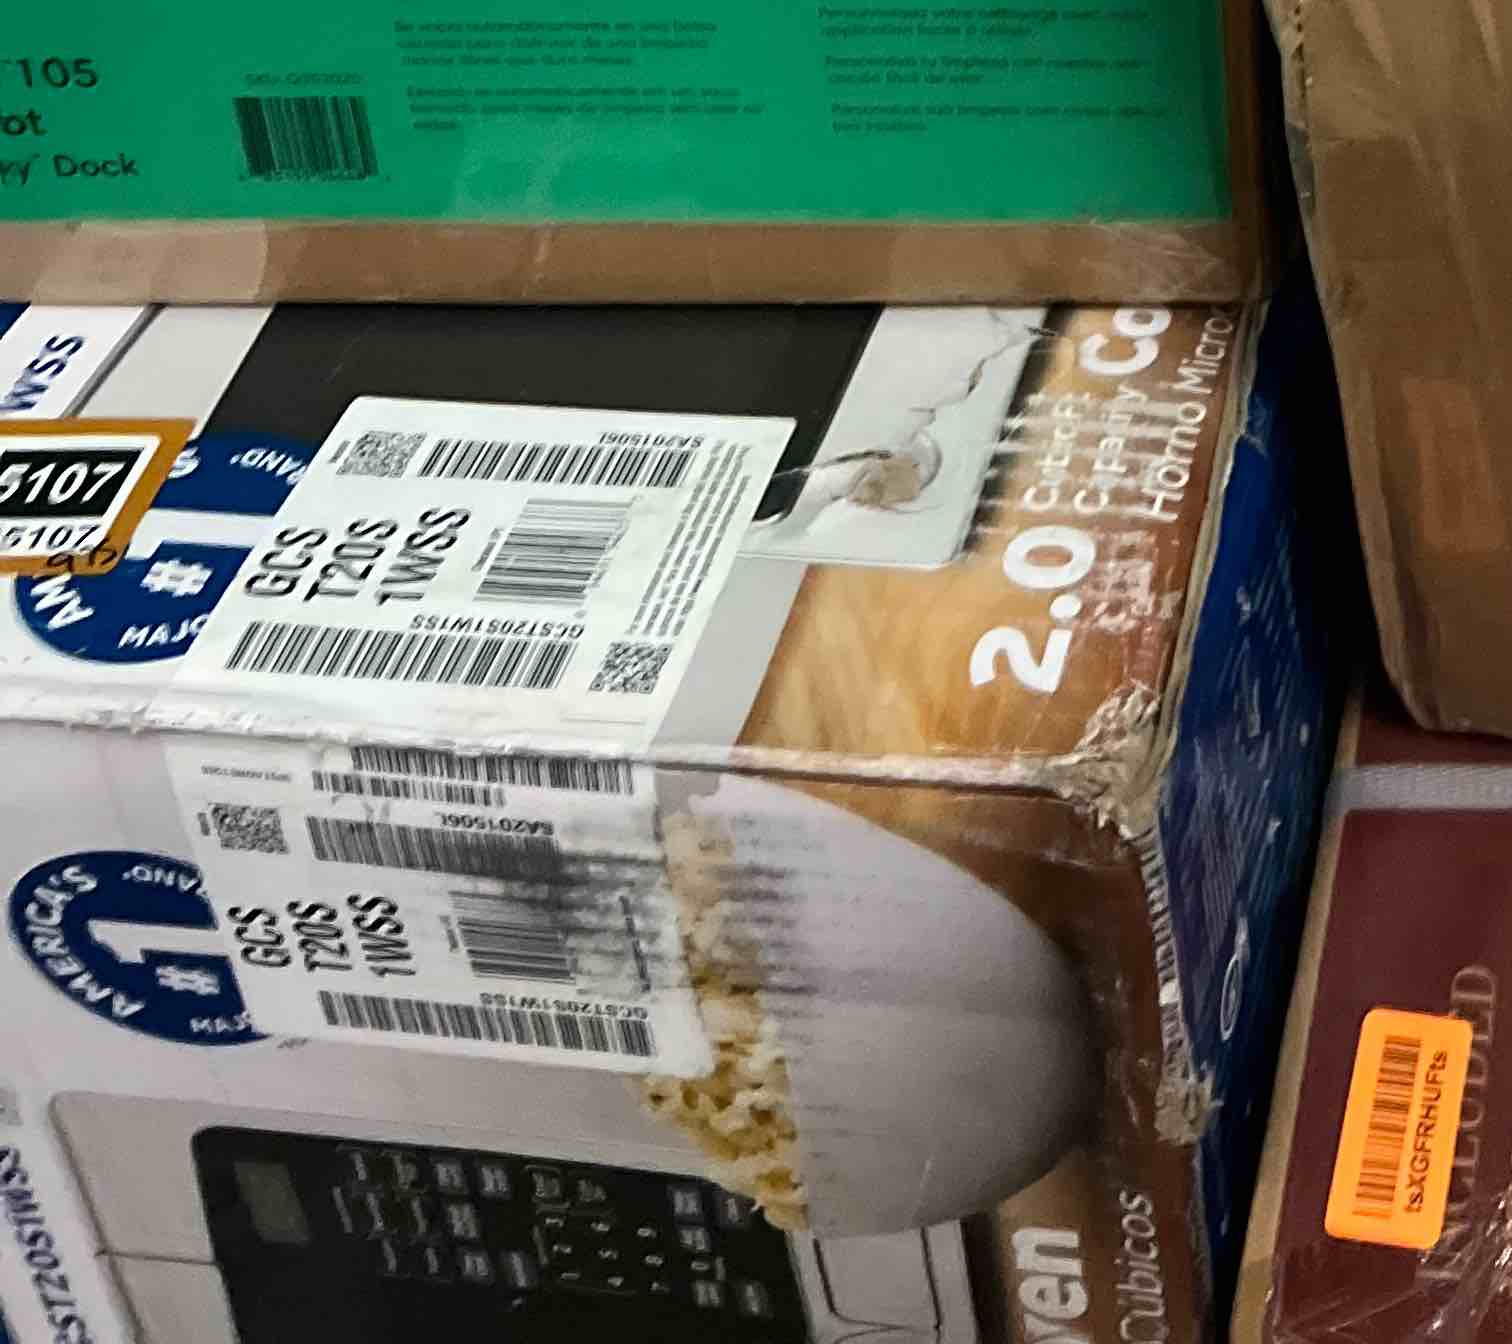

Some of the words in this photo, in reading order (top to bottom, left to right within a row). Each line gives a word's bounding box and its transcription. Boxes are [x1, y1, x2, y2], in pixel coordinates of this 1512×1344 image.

[53, 152, 140, 178] Dock
[1143, 401, 1207, 523] Horno
[245, 526, 328, 599] GCS
[302, 518, 399, 607] T20S
[377, 507, 471, 605] 1WSS
[969, 523, 1098, 693] 2.0
[228, 904, 292, 968] GCS
[287, 898, 353, 973] T20S
[347, 892, 415, 978] 1WSS
